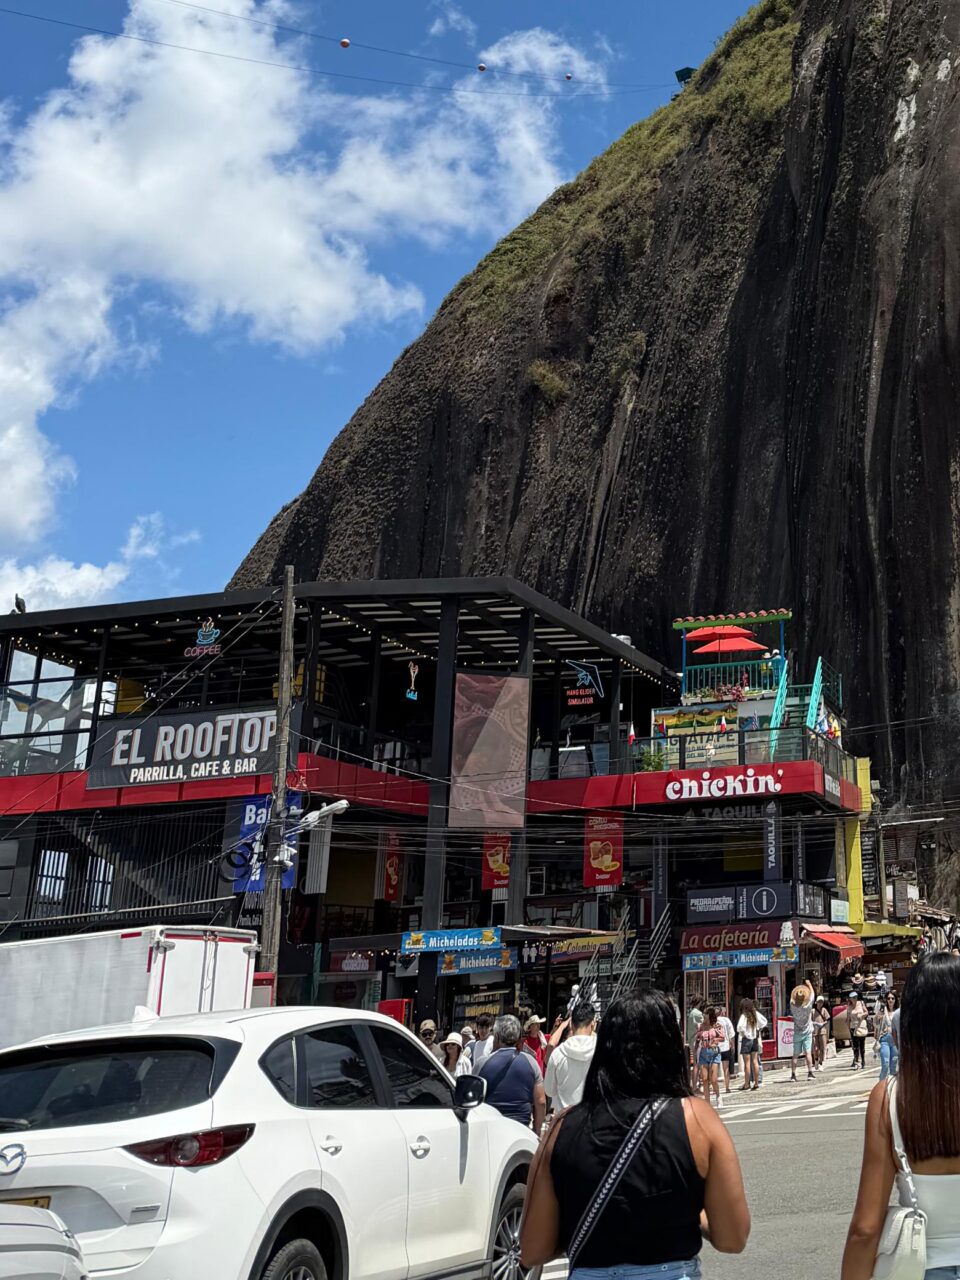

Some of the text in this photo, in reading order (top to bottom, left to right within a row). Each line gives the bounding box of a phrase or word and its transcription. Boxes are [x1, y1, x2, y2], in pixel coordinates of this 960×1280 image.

[184, 644, 222, 657] COFFEE
[112, 711, 278, 766] EL ROOFTOP
[130, 757, 257, 783] PARRILLA, CAFE & BAR
[702, 805, 763, 819] TAQUIL
[768, 816, 776, 868] TAQUILLA
[429, 934, 478, 948] Micheladas
[680, 925, 769, 951] La cafetería
[460, 955, 497, 969] Micheladas
